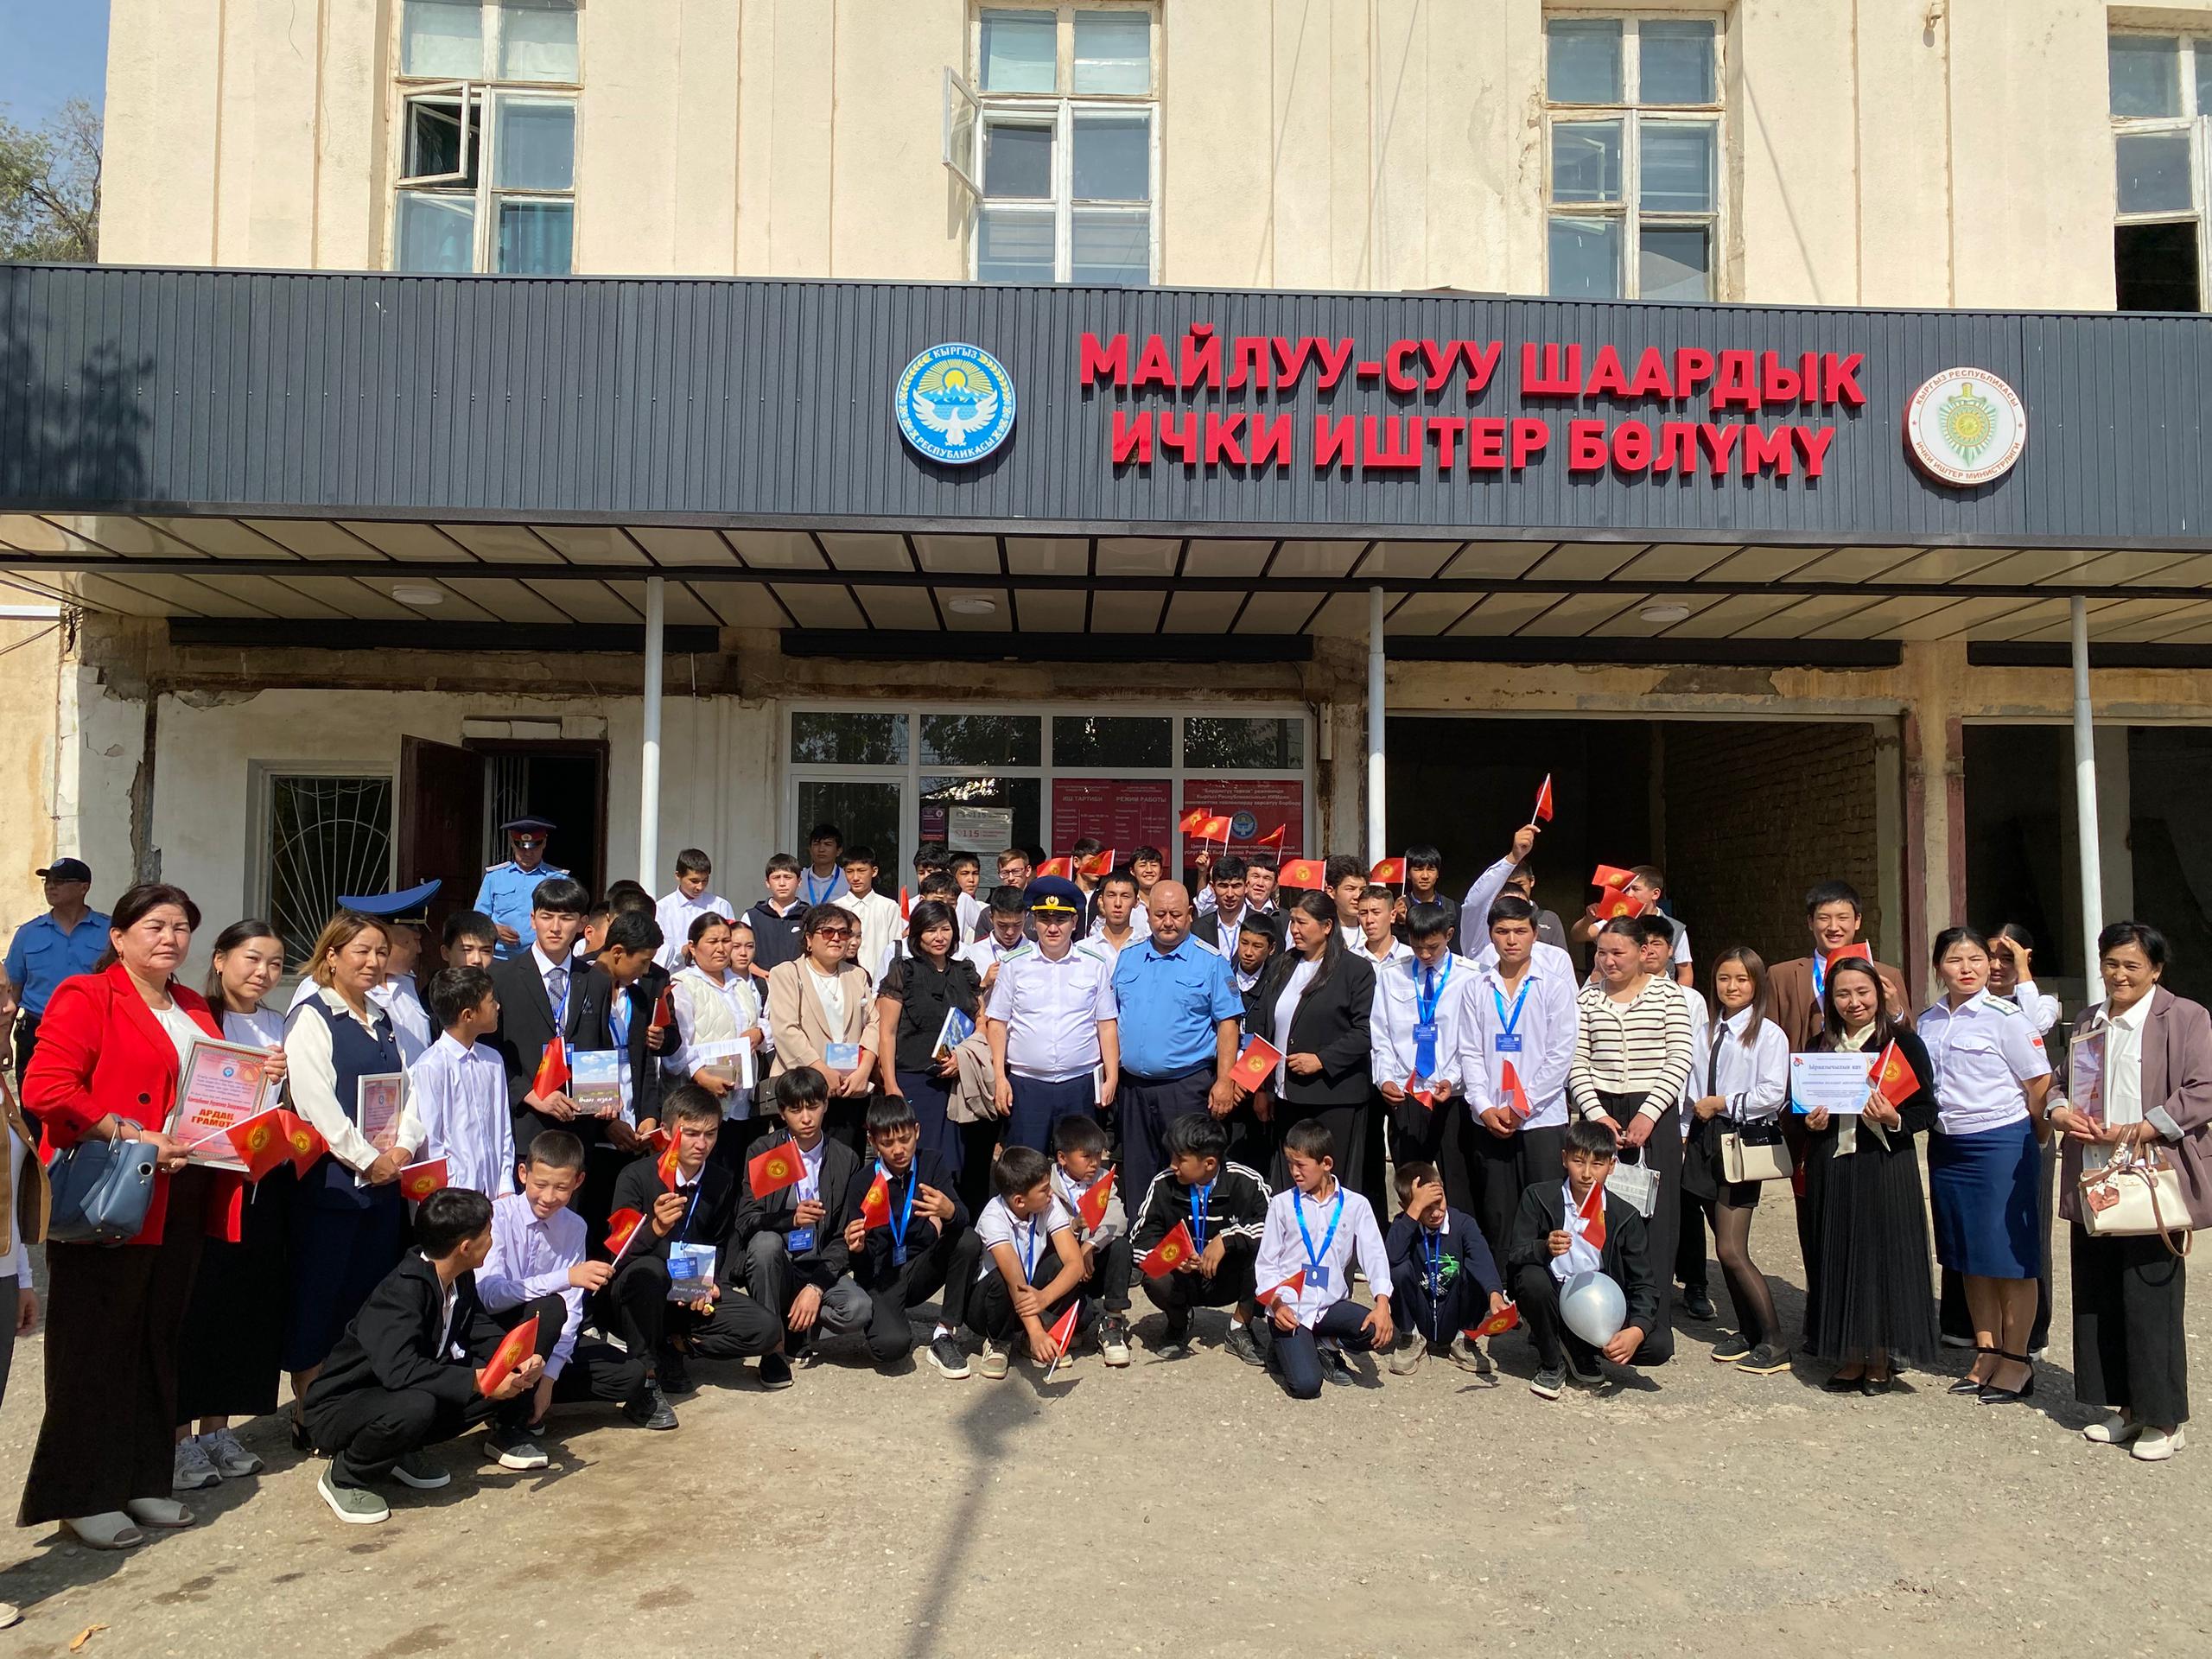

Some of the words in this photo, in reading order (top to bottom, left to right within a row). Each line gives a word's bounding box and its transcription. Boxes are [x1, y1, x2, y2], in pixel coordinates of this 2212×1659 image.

[933, 346, 978, 359] КЫРГЫЗ
[1080, 323, 1503, 393] МАЙЛУУ-СУУ
[1521, 341, 1866, 412] ШААРДЫК
[1916, 374, 1947, 405] КЫРГЫЗ
[1948, 370, 2018, 407] РЕСПУБЛИКАСЫ
[916, 436, 996, 459] РЕСПУБЛИКАСЫ
[1112, 410, 1292, 468] ИЧКИ
[1315, 414, 1550, 469] ИШТЕР
[1568, 418, 1835, 478] БӨЛҮМҮ
[1916, 442, 1935, 462] ИЧКИ
[1934, 461, 1964, 479] ИШТЕР
[1966, 442, 2020, 479] МИНИСТРЛИГИ
[191, 1116, 236, 1128] ГРАМОТ
